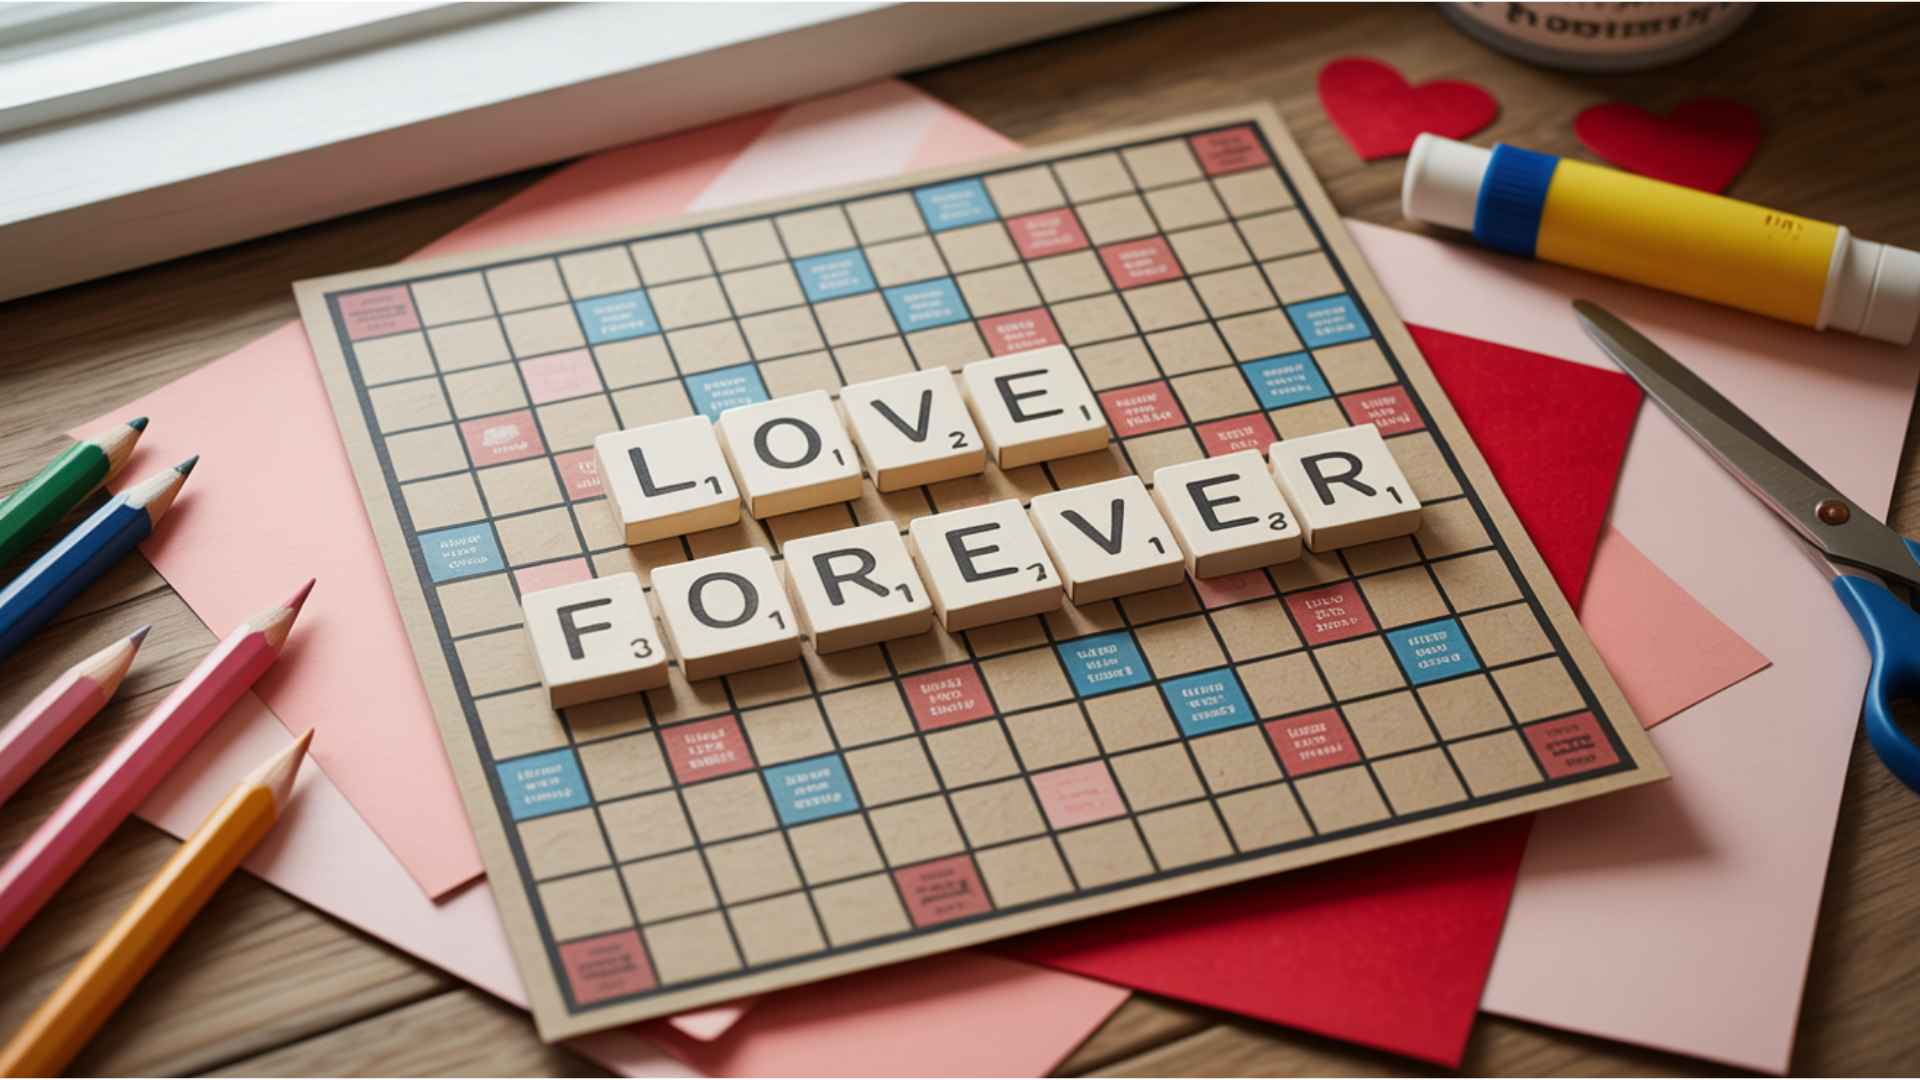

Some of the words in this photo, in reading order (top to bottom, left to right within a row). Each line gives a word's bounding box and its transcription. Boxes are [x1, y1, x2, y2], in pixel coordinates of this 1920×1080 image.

[628, 368, 1064, 498] LOVE
[948, 430, 969, 449] 2
[832, 448, 846, 466] 1
[704, 475, 723, 495] 1
[1386, 485, 1403, 505] 1
[1148, 536, 1165, 554] 1
[556, 451, 1378, 661] FOREVER
[895, 582, 914, 602] 1
[769, 610, 786, 629] 1
[629, 637, 653, 658] 3
